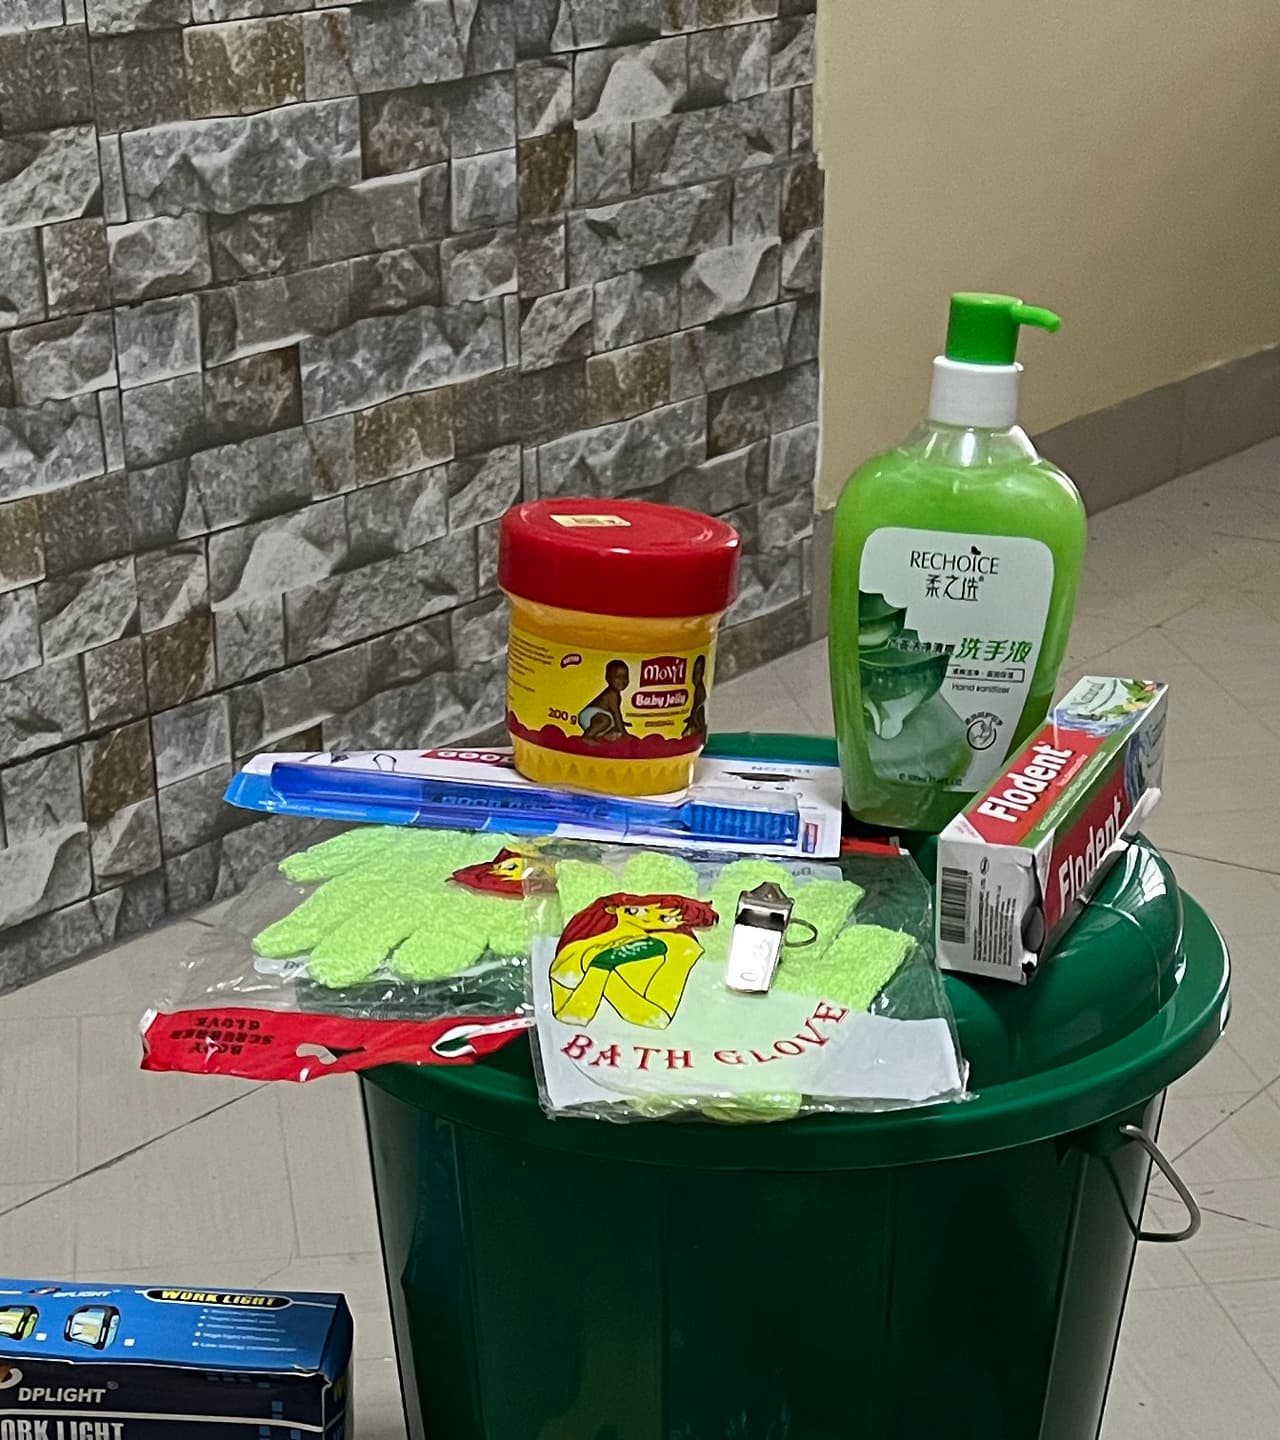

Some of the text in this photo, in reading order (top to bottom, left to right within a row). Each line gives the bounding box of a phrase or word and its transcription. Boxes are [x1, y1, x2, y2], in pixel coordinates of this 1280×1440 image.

[910, 548, 1000, 575] RECHOICE
[955, 637, 1033, 664] 洗手液
[951, 682, 975, 693] Hand
[635, 694, 664, 707] Baby
[548, 707, 568, 722] 200
[977, 743, 1073, 823] Flodent
[193, 1017, 260, 1029] GLOVE
[560, 1001, 850, 1071] BATH GLOVE
[161, 1289, 276, 1306] WORK LIGHT
[18, 1387, 107, 1403] DPLIGHT
